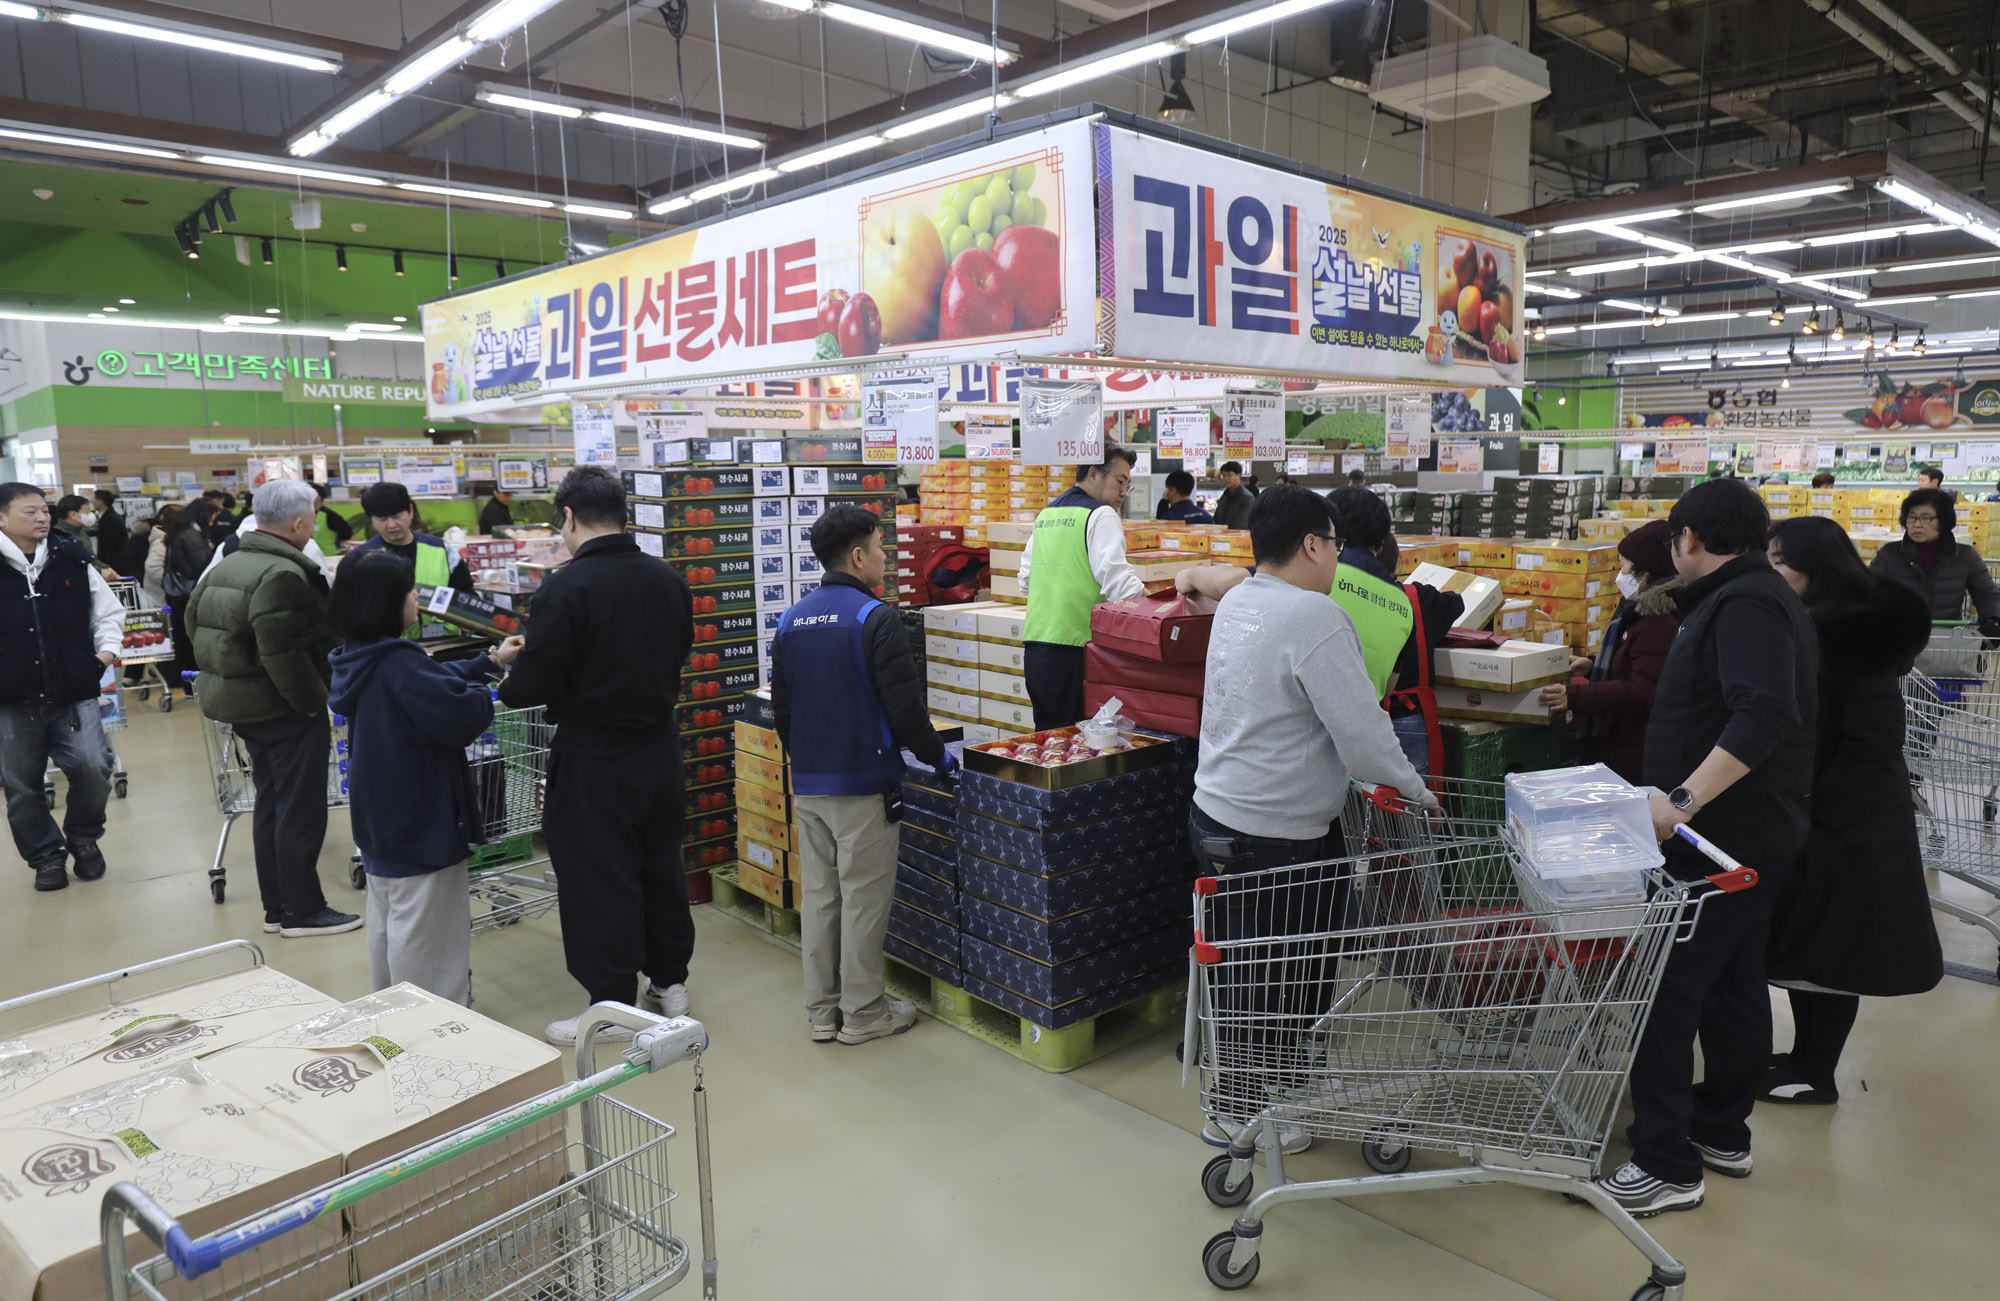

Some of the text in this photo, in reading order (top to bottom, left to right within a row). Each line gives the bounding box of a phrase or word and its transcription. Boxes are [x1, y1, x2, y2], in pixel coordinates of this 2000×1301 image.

[1319, 225, 1347, 246] 2025
[1133, 174, 1300, 336] 과일
[1313, 248, 1421, 319] 설날 선물
[545, 237, 819, 381] 과일 선물세트
[473, 324, 542, 381] 설날 선물
[133, 350, 332, 381] 고객만족센터
[303, 383, 426, 401] NATURE REPU
[900, 445, 935, 461] 73,800
[1057, 440, 1100, 459] 135,000
[1184, 447, 1209, 457] 98,800
[1254, 446, 1282, 457] 103,000
[1489, 440, 1504, 451] Fruits
[1338, 578, 1370, 601] 하나로
[793, 614, 839, 628] 하나로마트
